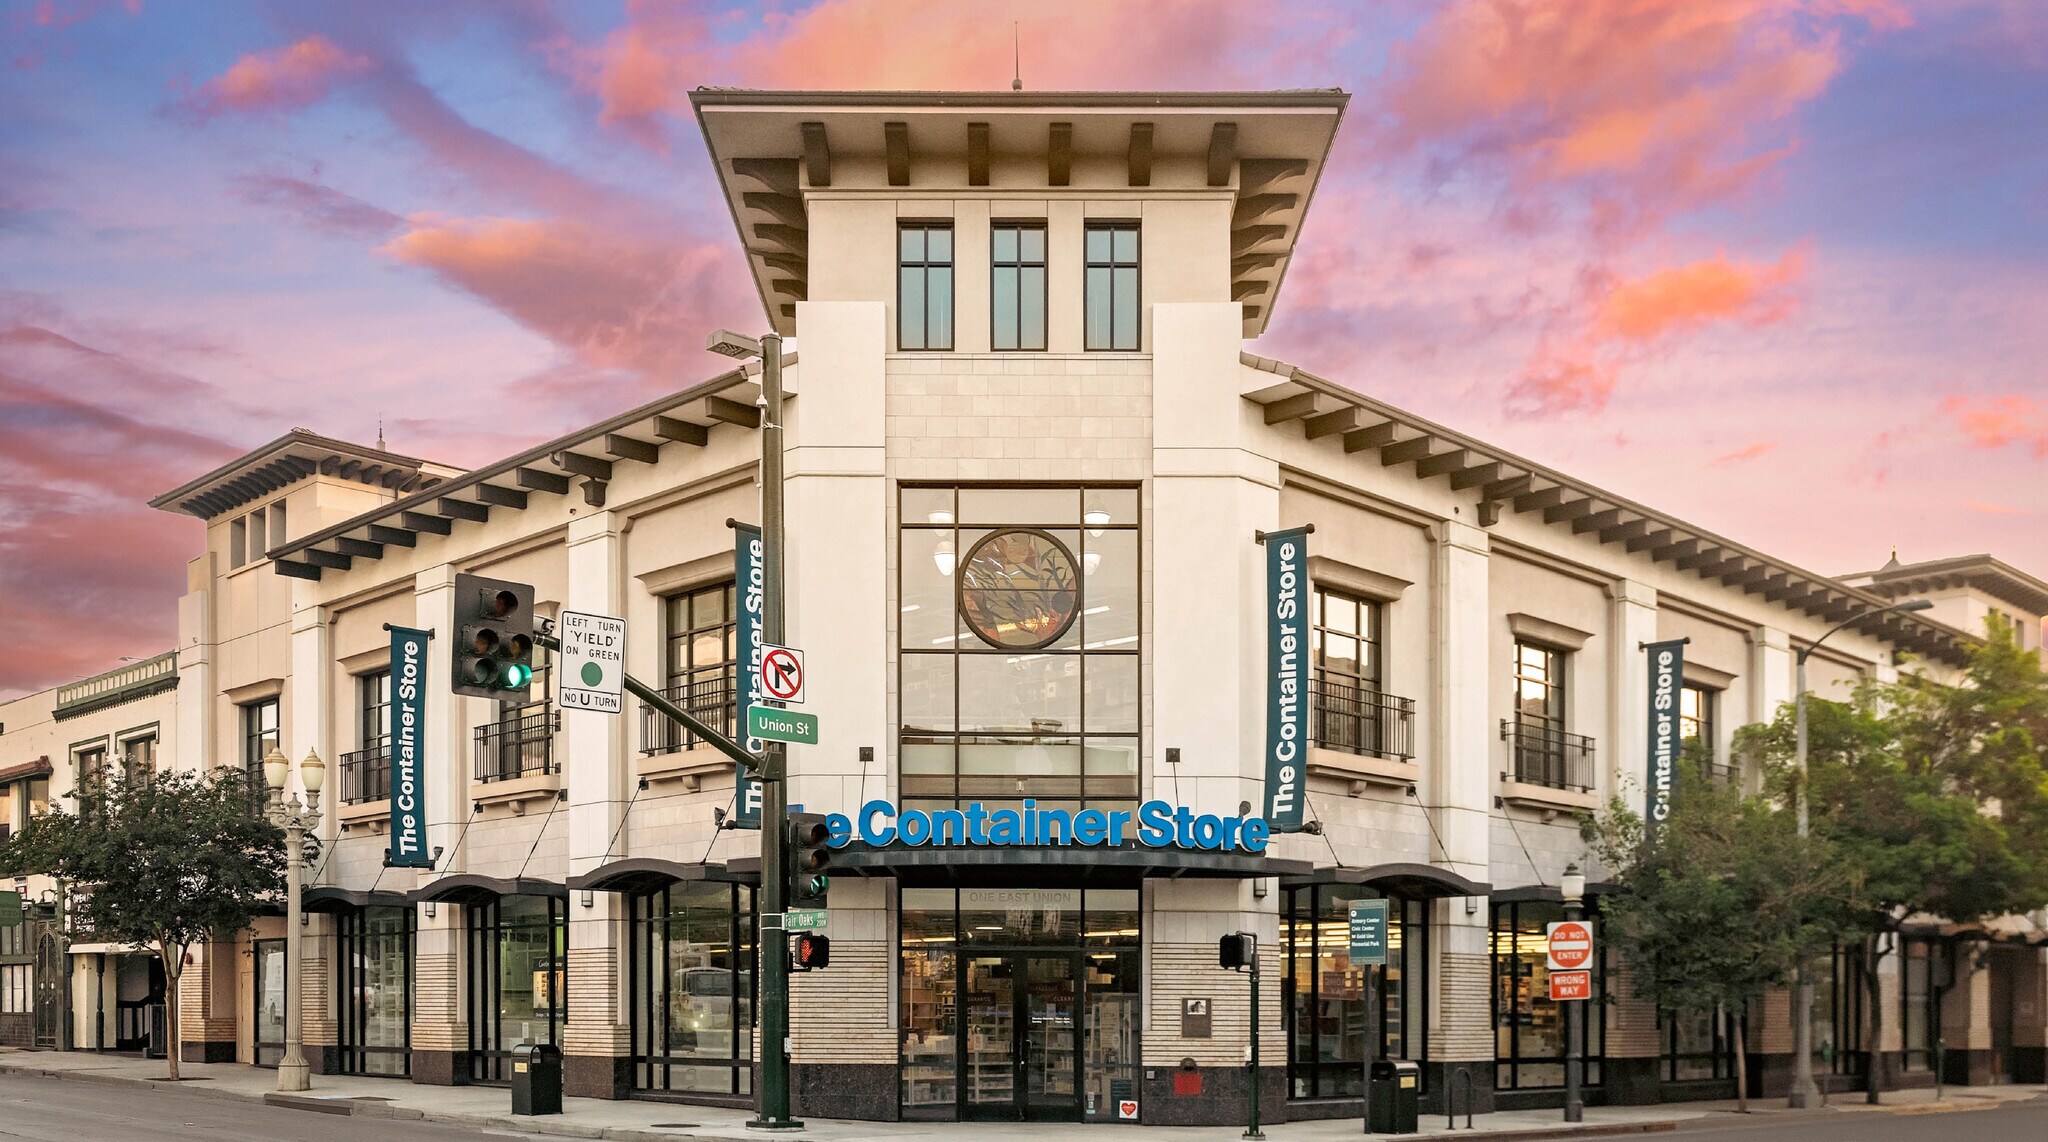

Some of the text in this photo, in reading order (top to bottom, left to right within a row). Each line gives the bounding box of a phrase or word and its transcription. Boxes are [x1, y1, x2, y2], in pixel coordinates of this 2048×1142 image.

[745, 539, 762, 613] Store
[566, 617, 621, 633] LEFT TURN
[566, 646, 620, 661] ON GREEN
[1272, 542, 1297, 819] The Container Store
[1655, 651, 1674, 711] Store
[564, 693, 617, 708] NO U TURN
[759, 716, 810, 736] Union St
[397, 640, 419, 856] The Container Store
[1653, 715, 1672, 821] Container
[858, 798, 1132, 848] Container
[1137, 800, 1271, 853] Store
[969, 892, 1071, 902] ONE EAST UNION
[785, 914, 797, 927] Fair
[798, 913, 814, 927] Oaks
[1554, 931, 1585, 940] DO NOT
[1557, 951, 1583, 960] ENTER
[1554, 975, 1585, 985] WRONG
[1560, 986, 1580, 996] WAY
